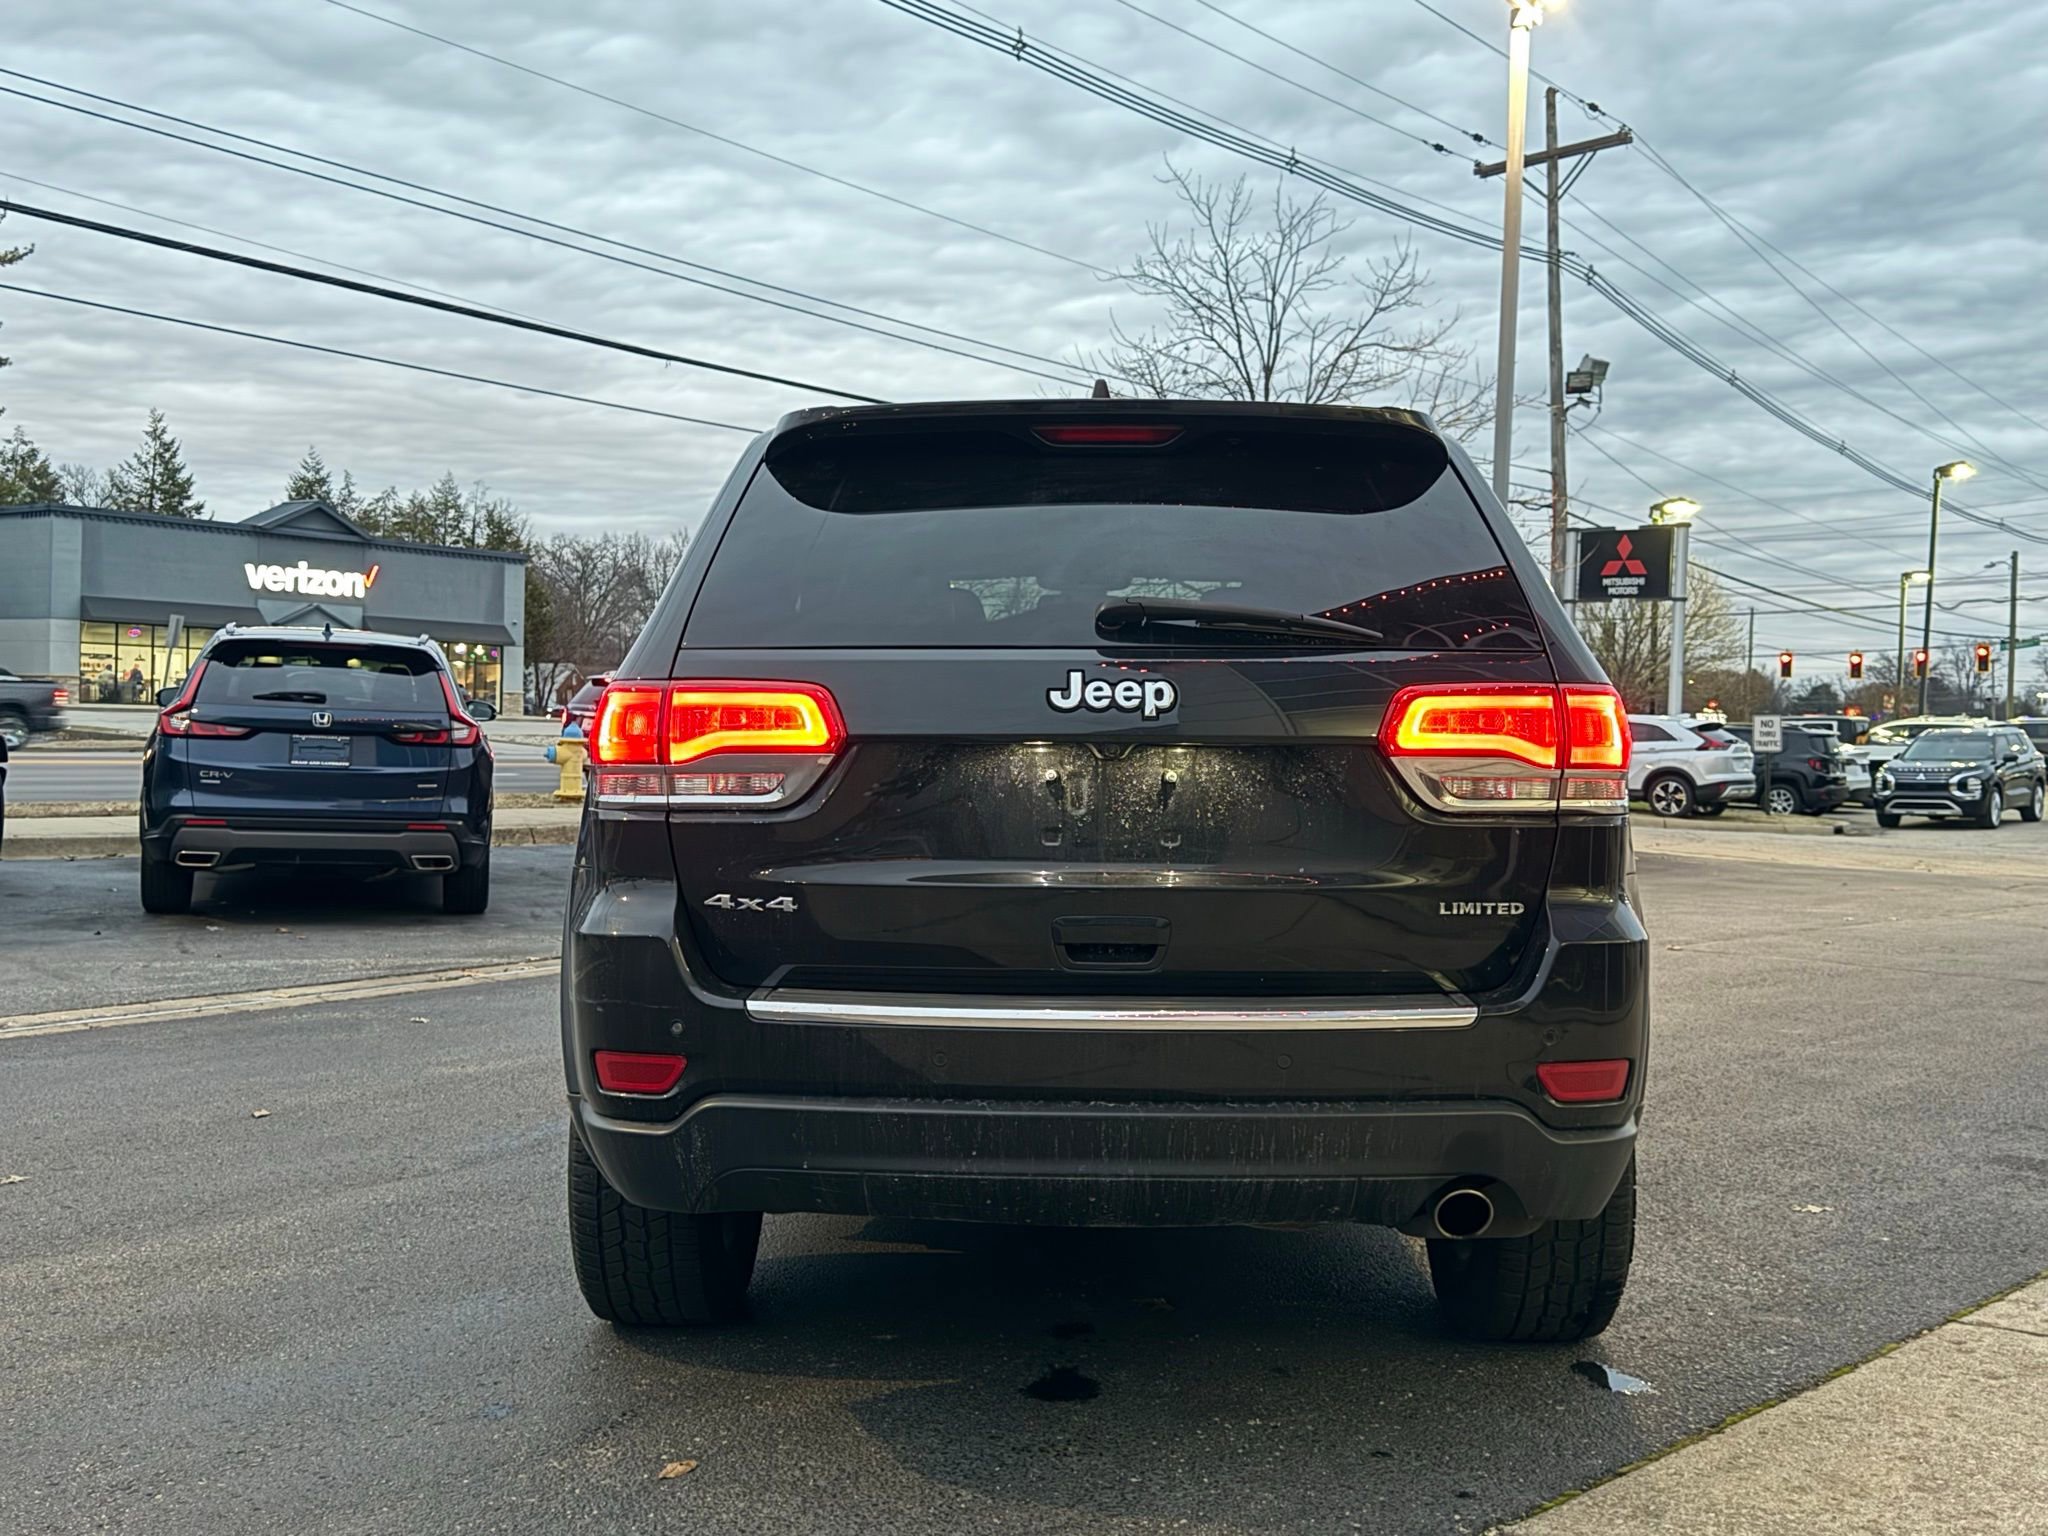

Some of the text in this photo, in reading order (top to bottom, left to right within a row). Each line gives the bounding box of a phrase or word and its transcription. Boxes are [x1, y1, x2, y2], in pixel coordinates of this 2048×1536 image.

[244, 560, 366, 598] verizon
[1602, 577, 1646, 587] MITSUBISHI
[1607, 586, 1639, 595] MOTORS
[1048, 670, 1177, 718] Jeep
[1760, 719, 1774, 729] NO
[1759, 730, 1777, 738] THRU
[1755, 740, 1780, 748] TRAFFIC
[199, 770, 234, 779] CR-V
[703, 893, 798, 913] 4x4
[1439, 902, 1525, 915] LIMITED
